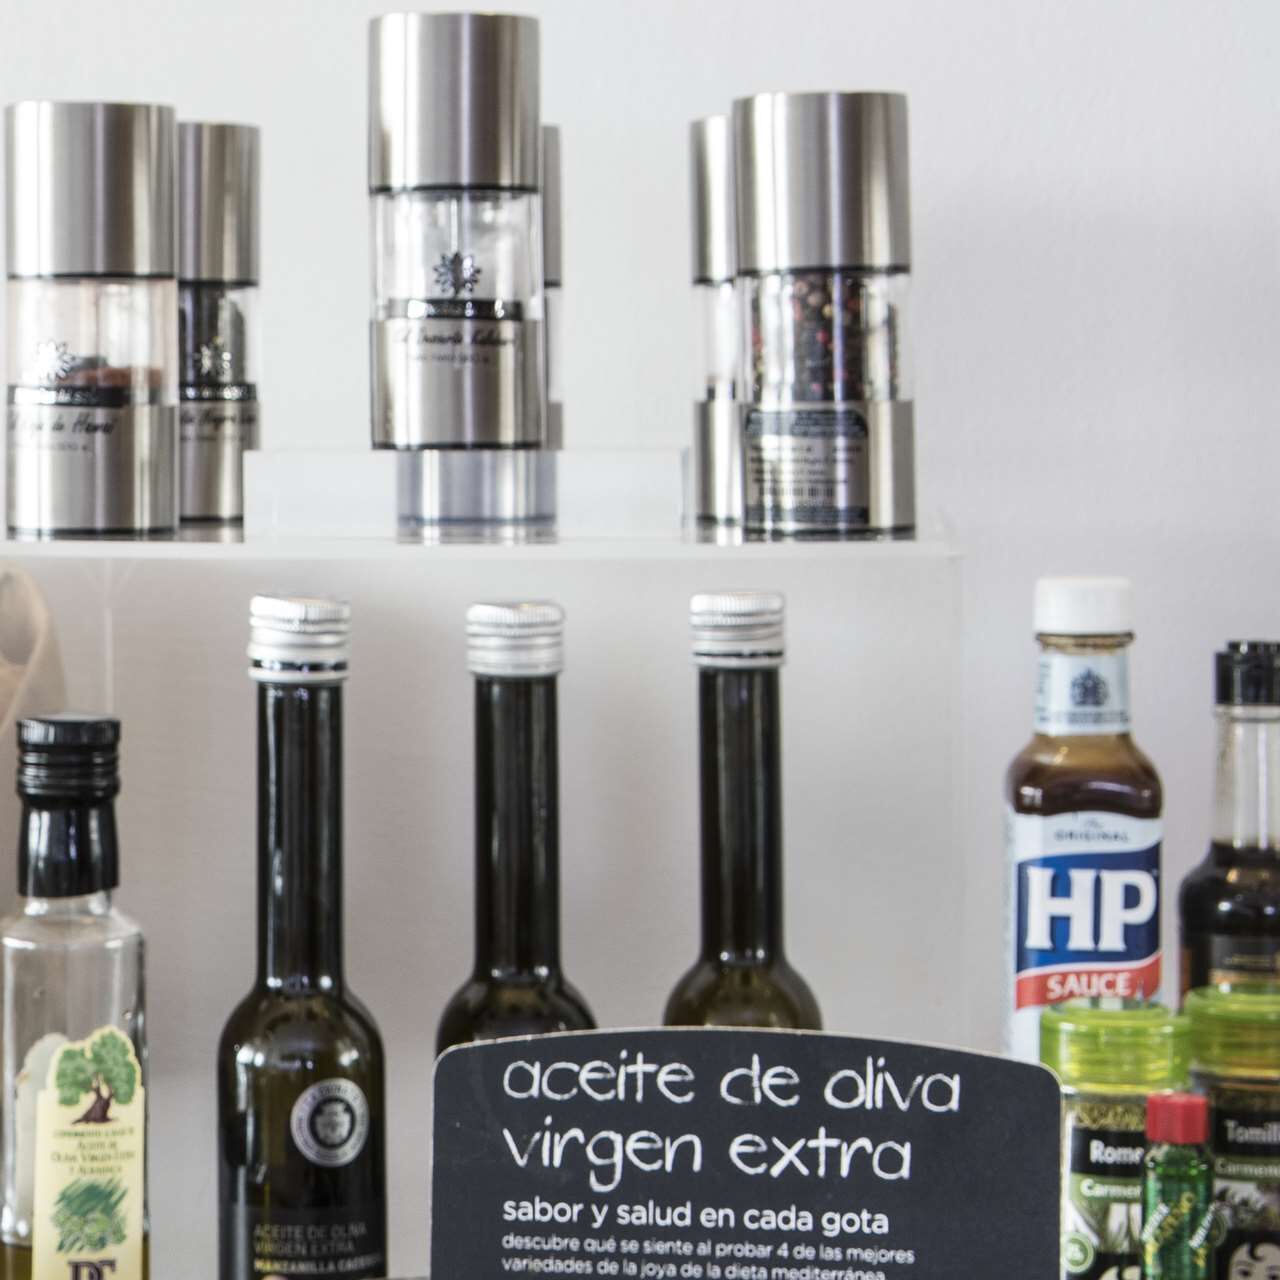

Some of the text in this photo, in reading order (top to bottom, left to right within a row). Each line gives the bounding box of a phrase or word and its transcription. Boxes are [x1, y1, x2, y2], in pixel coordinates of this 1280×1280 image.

[1025, 865, 1157, 952] HP
[1046, 971, 1132, 1000] SAUCE
[503, 1049, 960, 1113] aceite de oliva
[503, 1115, 911, 1193] virgen extra
[502, 1195, 889, 1237] sabor y salud en cada gota
[501, 1232, 915, 1265] descubre qué se siente al probar 4 de las mejores
[501, 1255, 593, 1274] variedades
[596, 1258, 619, 1275] de
[623, 1259, 637, 1276] la
[640, 1260, 677, 1279] joya
[680, 1260, 703, 1278] de
[707, 1261, 721, 1279] la
[724, 1263, 768, 1280] dieta
